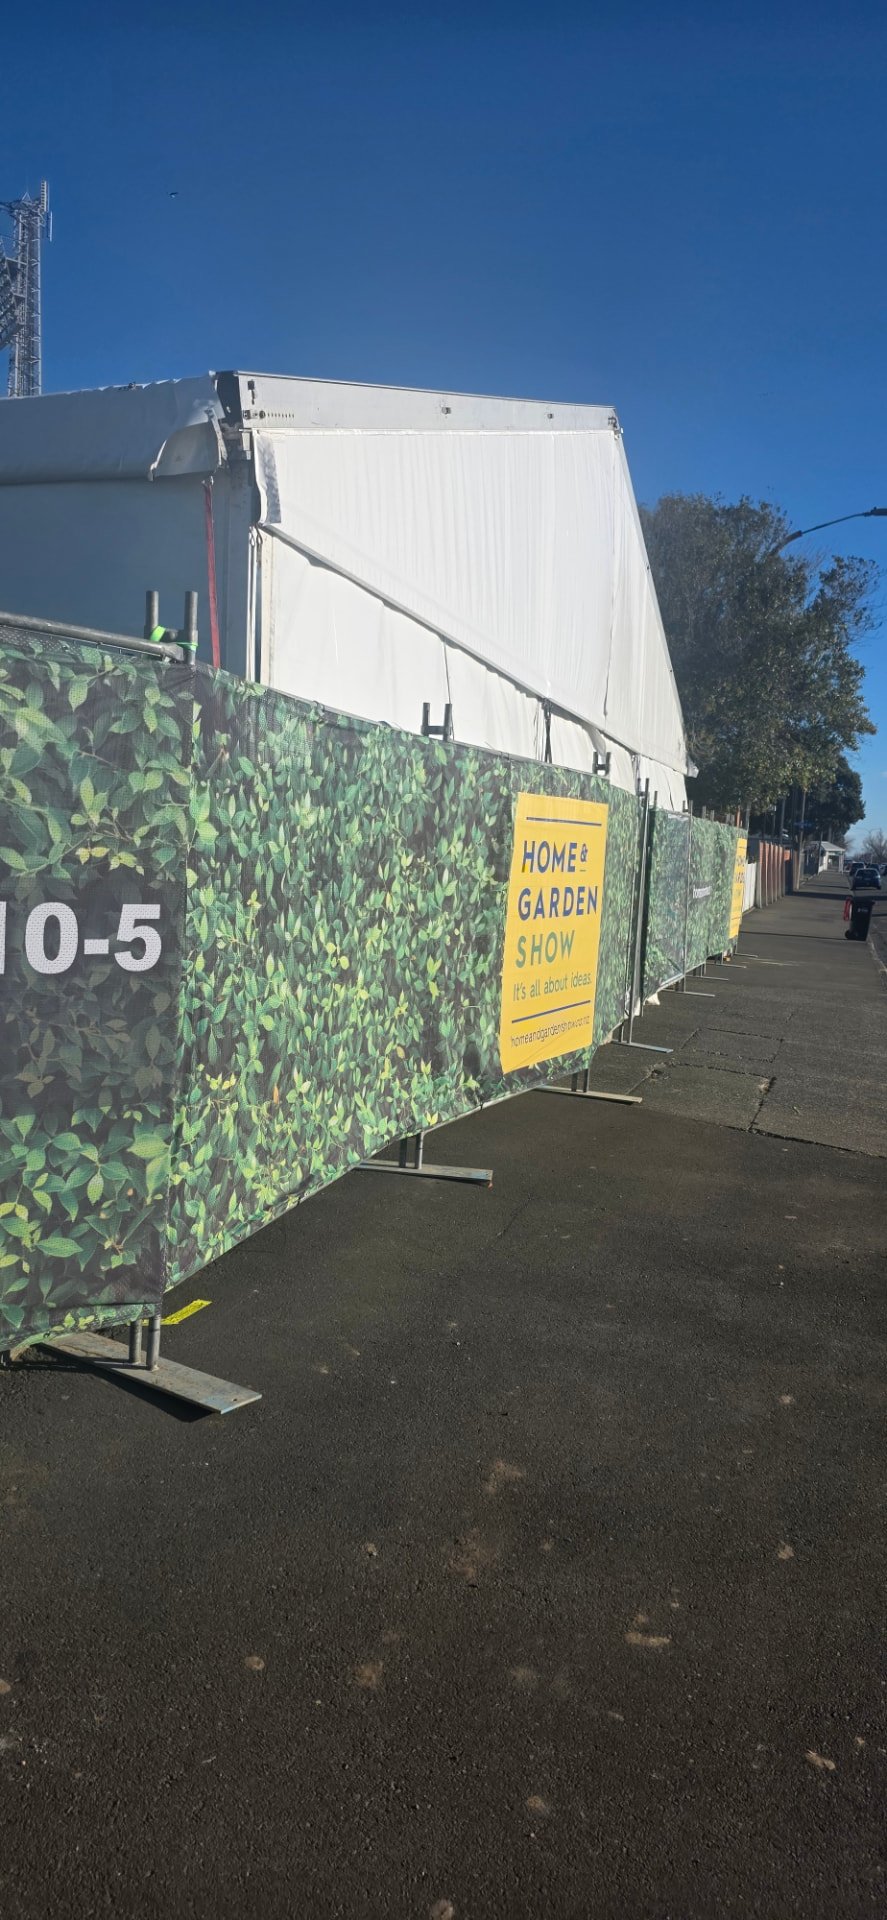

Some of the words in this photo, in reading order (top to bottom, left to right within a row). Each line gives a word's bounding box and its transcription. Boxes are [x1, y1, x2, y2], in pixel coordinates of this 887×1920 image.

[521, 840, 578, 873] HOME
[580, 843, 588, 862] &
[518, 886, 598, 921] GARDEN
[515, 929, 575, 968] SHOW
[512, 982, 526, 1001] It's
[529, 979, 541, 998] all
[544, 976, 568, 995] about
